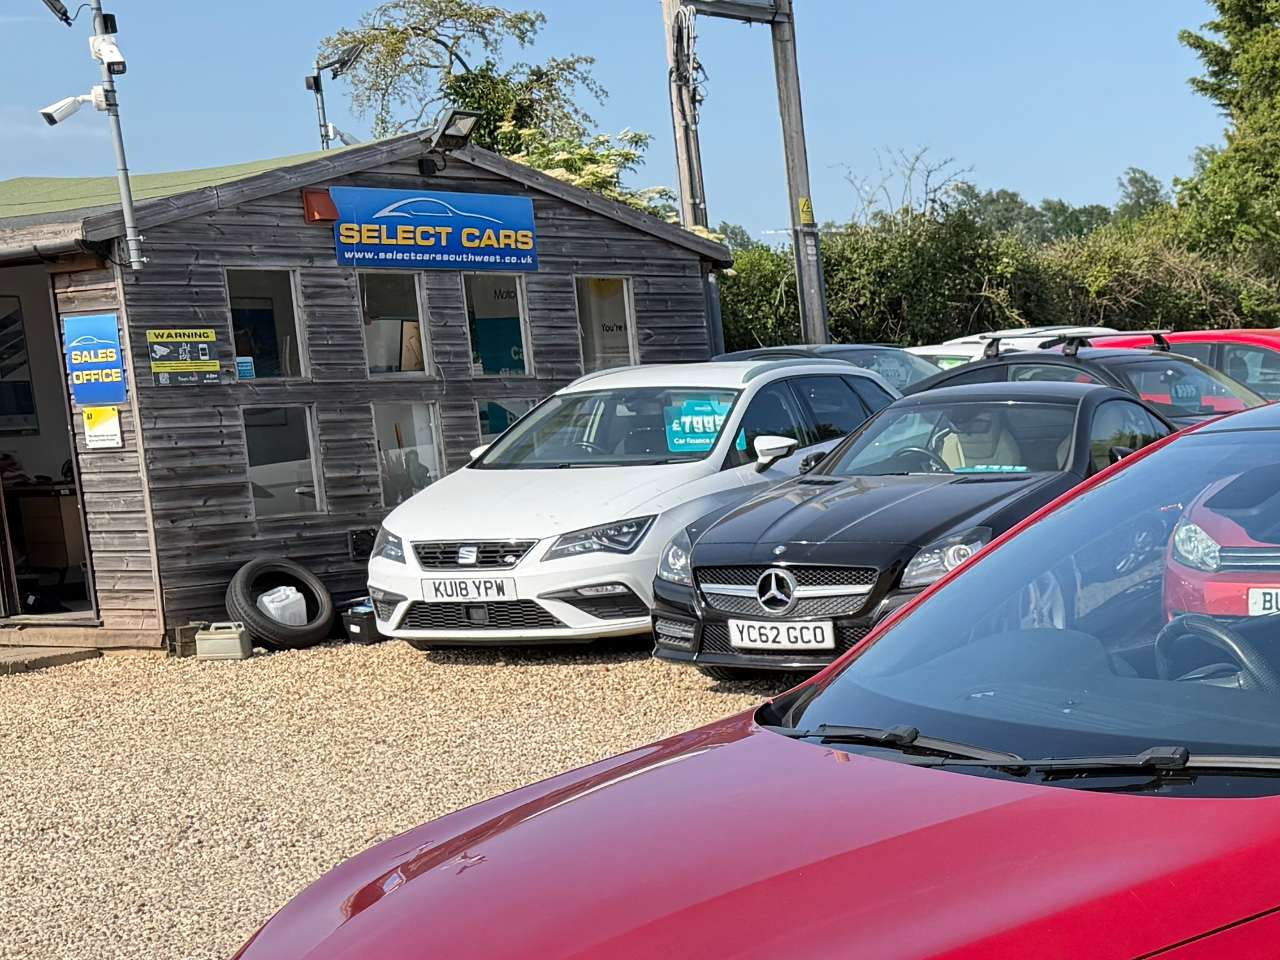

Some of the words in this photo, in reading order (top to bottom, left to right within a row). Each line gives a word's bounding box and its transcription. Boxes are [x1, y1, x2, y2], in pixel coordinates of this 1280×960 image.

[339, 223, 453, 247] SELECT
[461, 227, 534, 250] CARS
[344, 250, 533, 264] www.selectcarssouthwest.co.uk
[153, 331, 210, 340] WARNING
[71, 348, 117, 364] SALES
[73, 368, 122, 384] OFFICE
[433, 580, 470, 598] KU18
[472, 580, 505, 597] YPW
[736, 623, 782, 644] YC62
[786, 625, 825, 644] GCO
